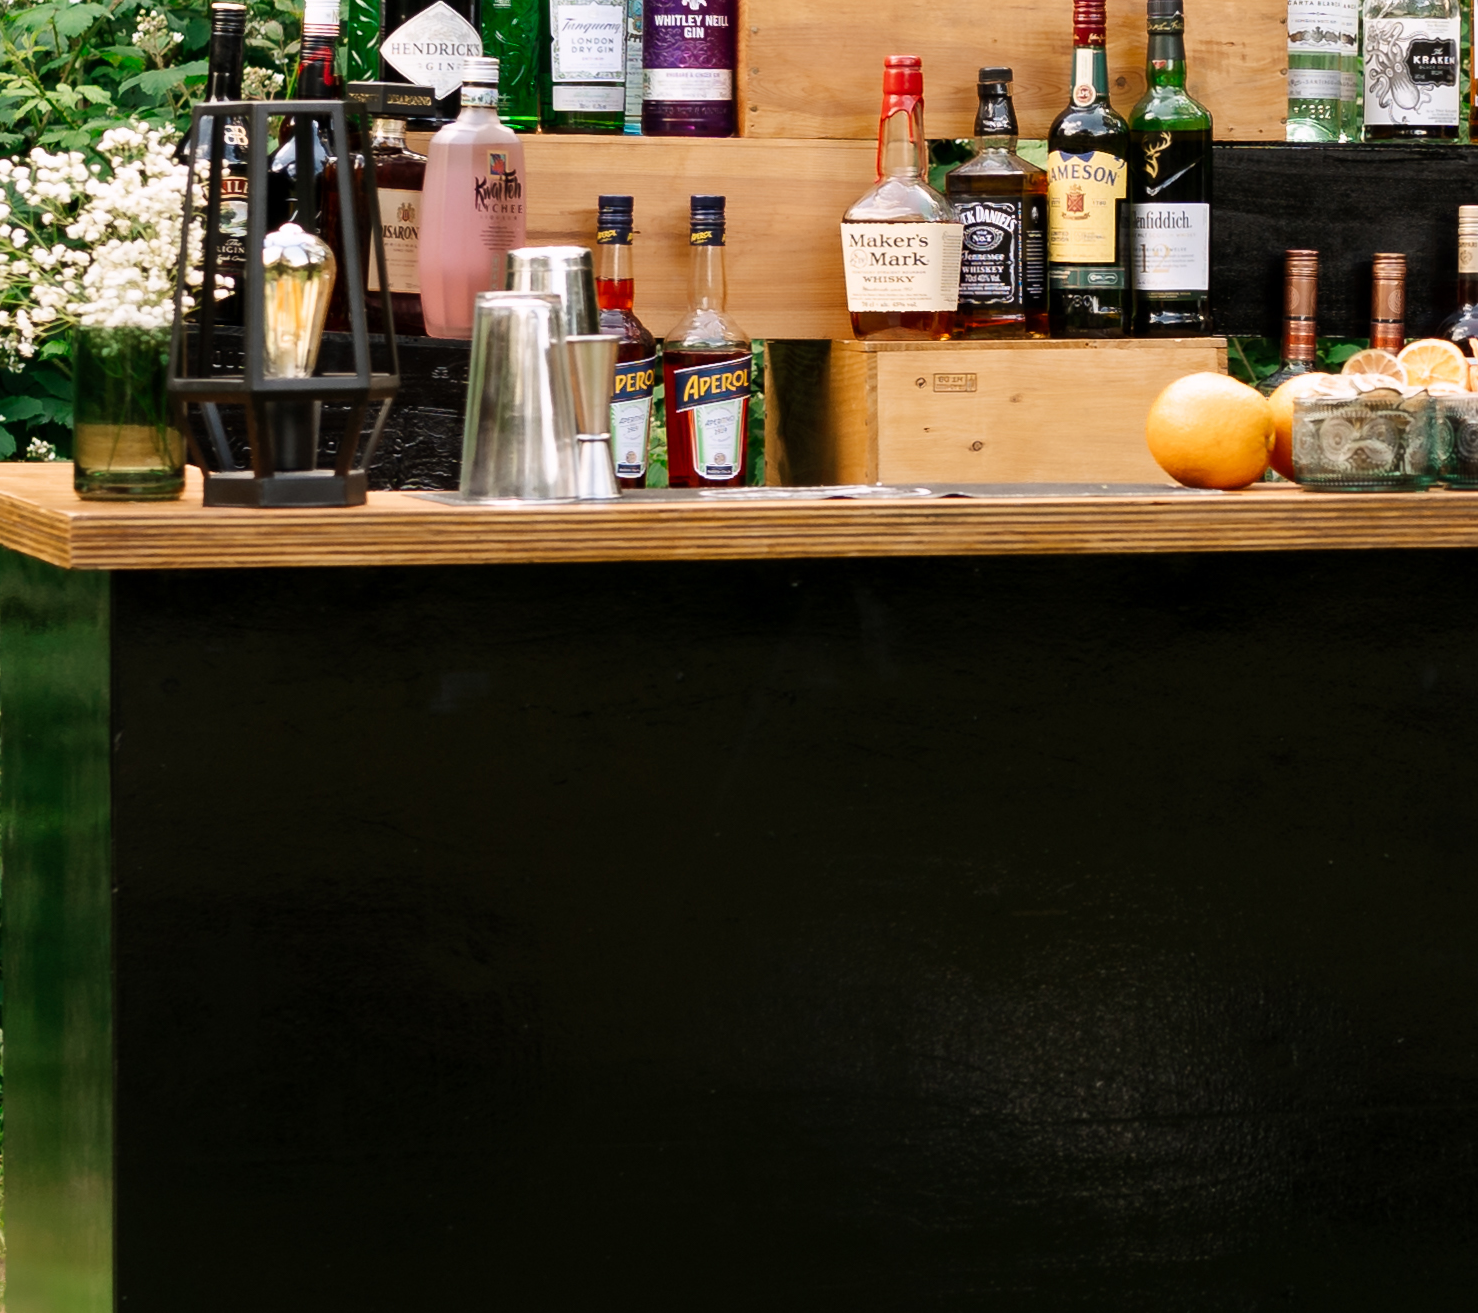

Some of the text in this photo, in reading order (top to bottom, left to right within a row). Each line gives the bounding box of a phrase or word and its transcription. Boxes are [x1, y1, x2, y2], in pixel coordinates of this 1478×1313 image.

[561, 17, 622, 35] Tanqueray
[654, 14, 729, 27] WHITLEY NEILL
[684, 27, 704, 39] GIN
[571, 38, 614, 46] LONDON
[391, 42, 481, 57] HENDRICK'S
[571, 46, 614, 54] DRY GIN
[1413, 55, 1456, 64] KRAKEN
[426, 63, 455, 72] GIN
[503, 169, 522, 201] Feh
[478, 203, 523, 214] LYCHEE
[849, 233, 929, 248] Maker's
[869, 252, 929, 266] Mark
[1139, 243, 1171, 273] 12
[683, 368, 749, 402] APEROL
